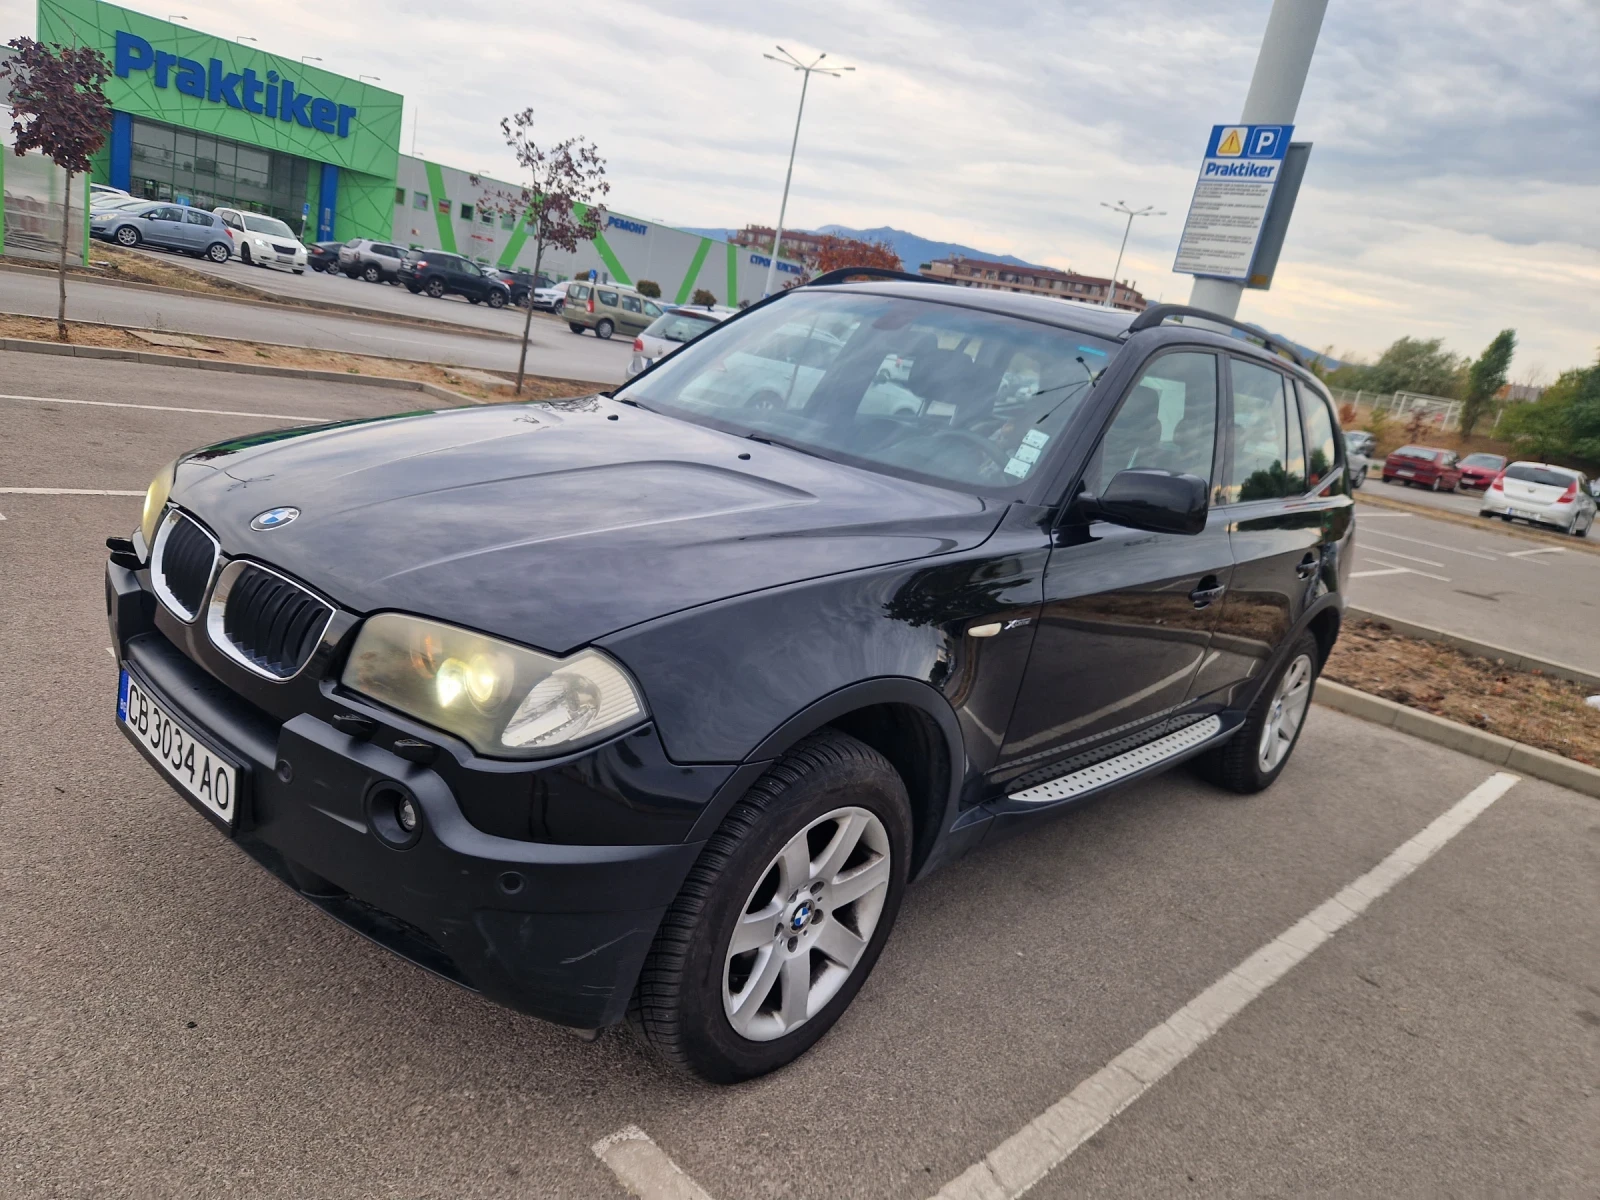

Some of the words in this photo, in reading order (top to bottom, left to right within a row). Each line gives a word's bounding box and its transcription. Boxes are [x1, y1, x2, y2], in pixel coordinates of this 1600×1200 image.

[114, 30, 357, 138] Praktiker
[1256, 131, 1275, 154] P
[1205, 162, 1275, 178] Praktiker
[608, 216, 648, 236] РЕМОНТ
